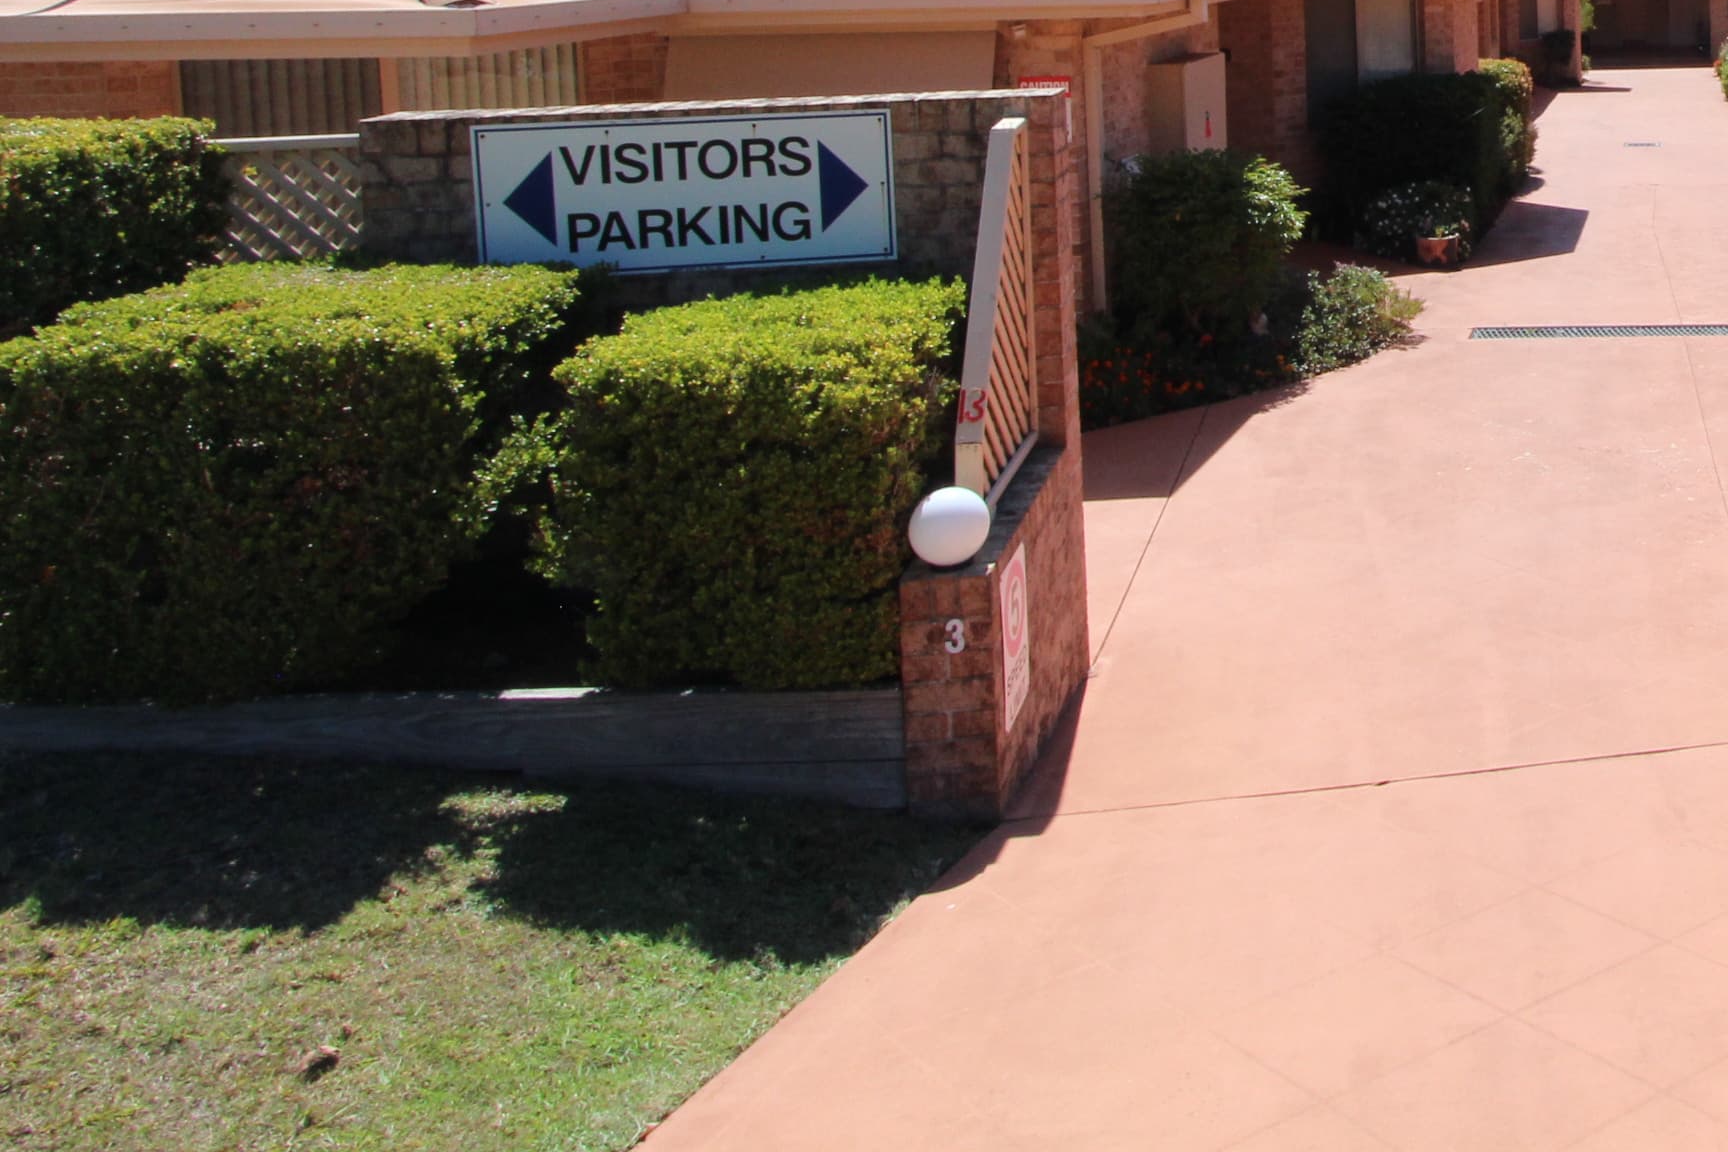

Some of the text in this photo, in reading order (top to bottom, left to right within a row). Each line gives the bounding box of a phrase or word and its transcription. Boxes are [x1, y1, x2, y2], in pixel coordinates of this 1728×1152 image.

[559, 136, 811, 186] VISITORS
[568, 201, 811, 253] PARKING
[944, 618, 965, 654] 3
